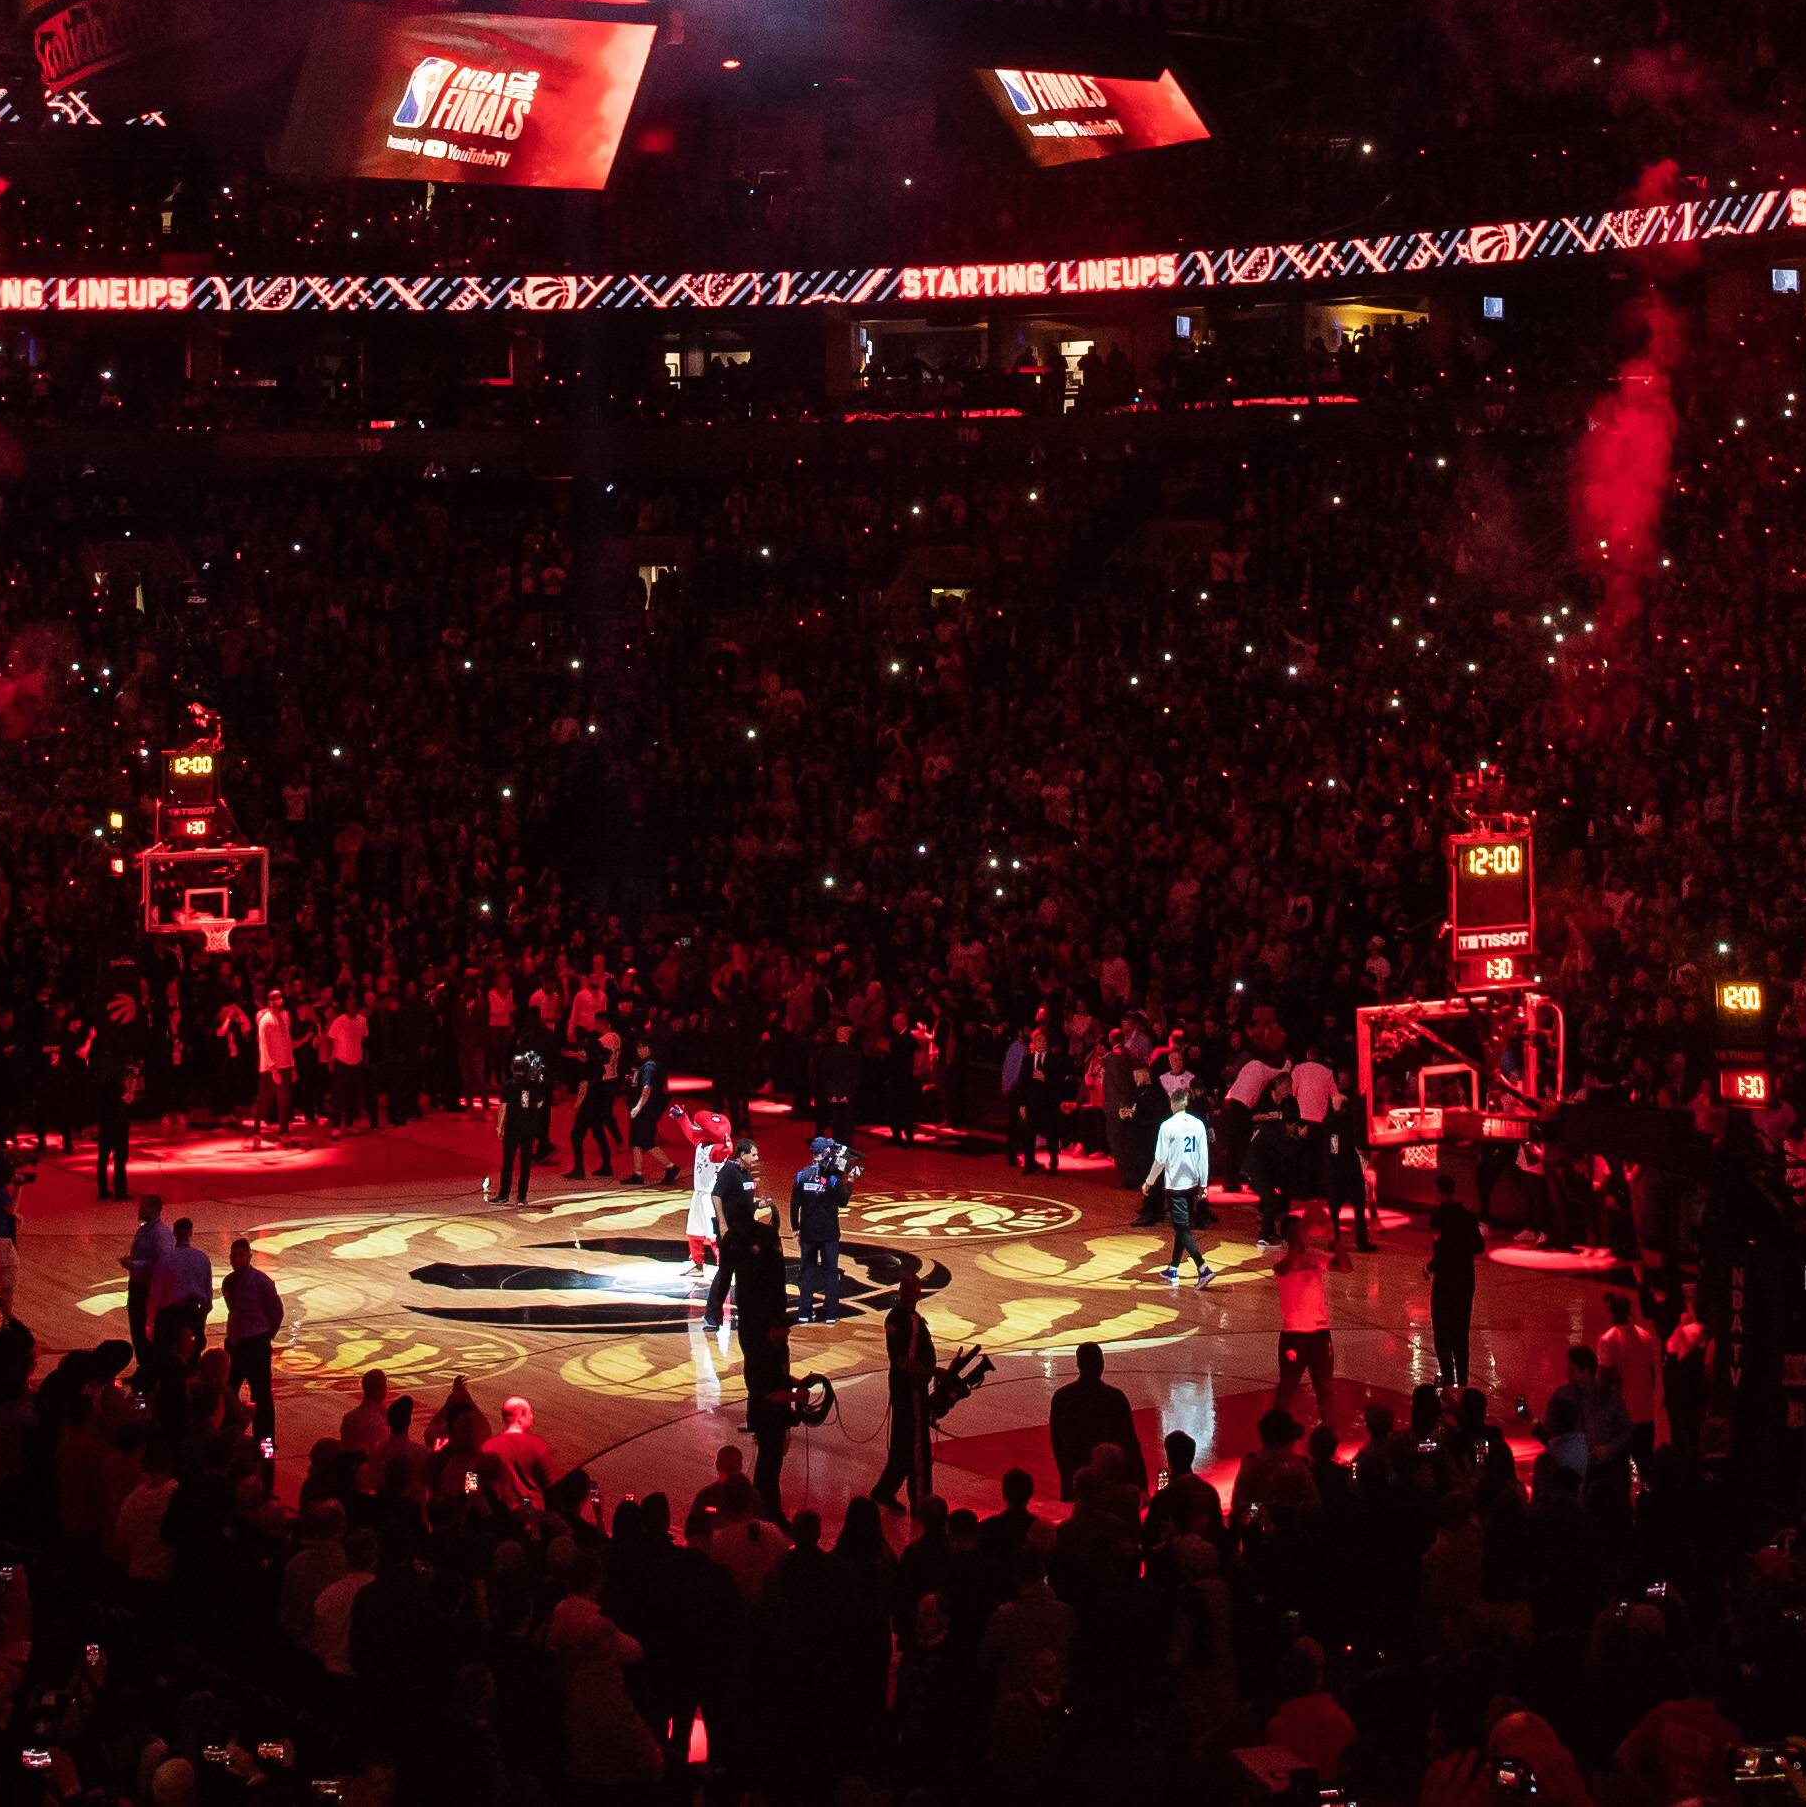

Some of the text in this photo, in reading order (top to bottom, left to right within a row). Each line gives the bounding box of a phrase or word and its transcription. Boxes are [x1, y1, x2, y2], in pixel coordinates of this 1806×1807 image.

[450, 67, 506, 94] NBA
[431, 88, 531, 140] FINALS
[902, 255, 1177, 298] STARTING LINEUPS
[58, 279, 190, 308] LINEUPS
[175, 756, 212, 774] 12:00
[1469, 846, 1520, 875] 12:00
[1477, 931, 1529, 949] TISSOT
[1486, 957, 1512, 979] 1:30
[1723, 986, 1760, 1010] 12:00
[1737, 1075, 1765, 1099] 1:30
[1184, 1136, 1196, 1153] 21
[1731, 1266, 1745, 1332] NBA
